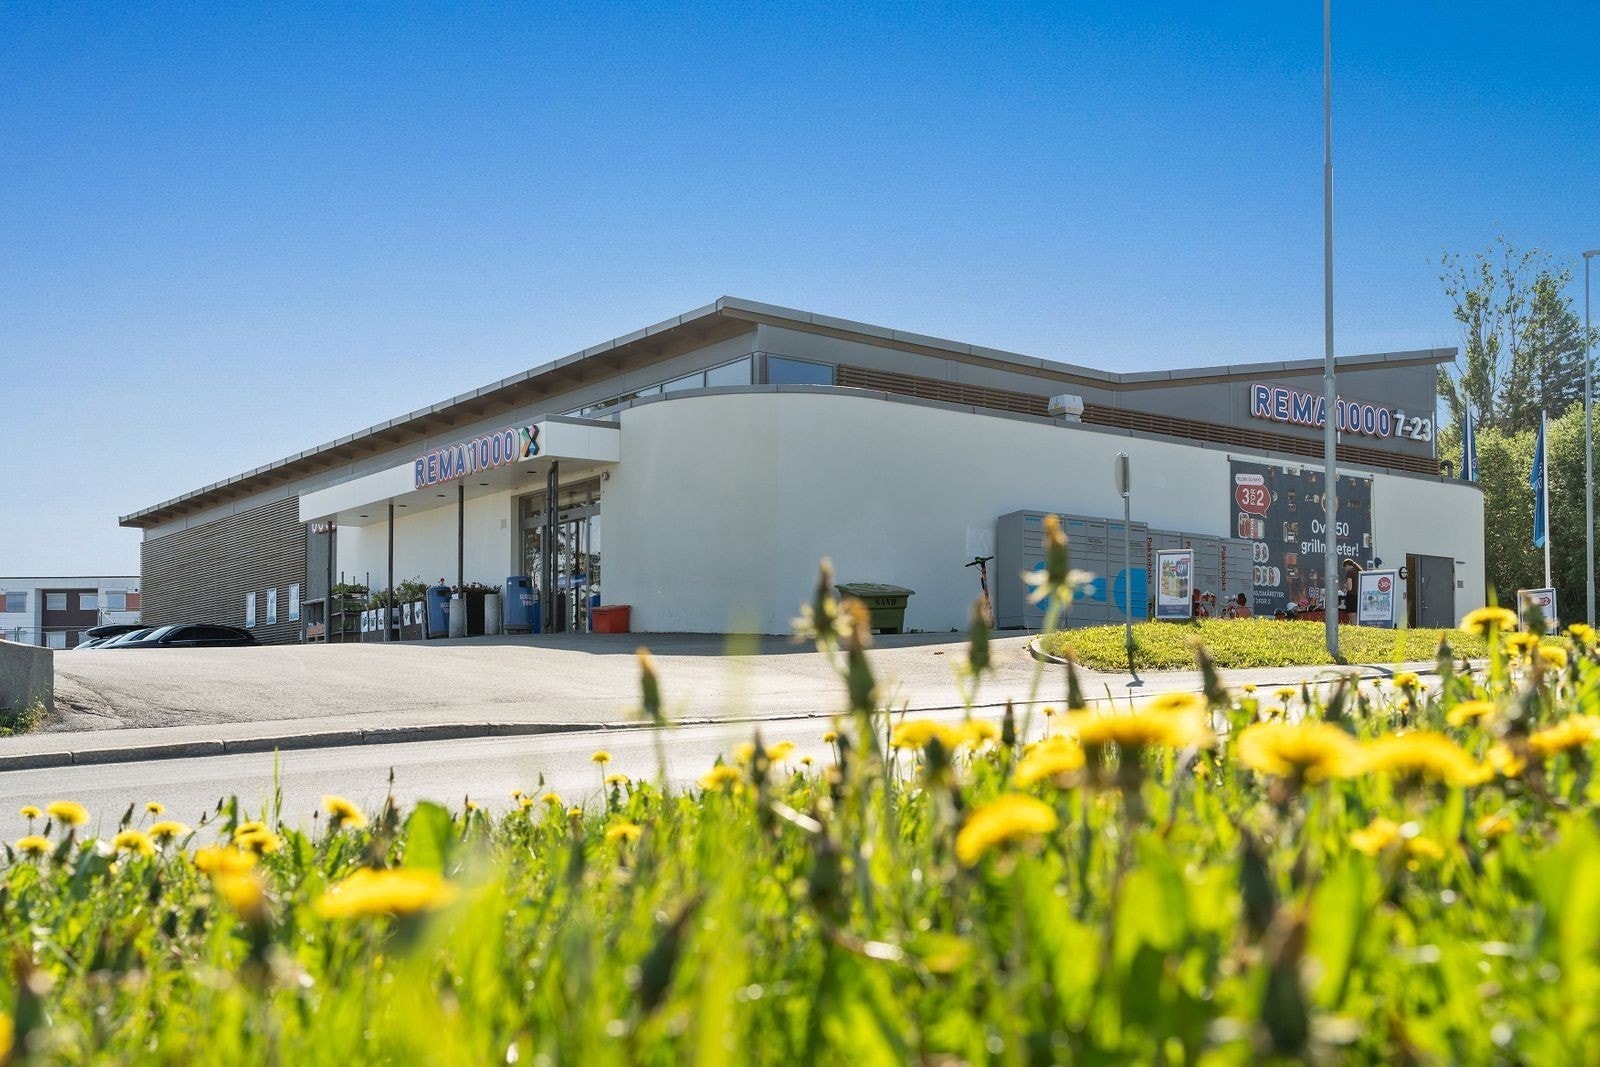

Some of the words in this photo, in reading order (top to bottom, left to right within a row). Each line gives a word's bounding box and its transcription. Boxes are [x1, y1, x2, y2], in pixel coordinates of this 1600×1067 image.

[1251, 384, 1326, 427] REMA
[1336, 399, 1392, 438] 1000
[1393, 412, 1432, 442] 7-23
[414, 444, 467, 490] REMA
[469, 428, 515, 473] 1000
[1242, 488, 1250, 505] 3
[1256, 489, 1265, 507] 2
[1311, 519, 1327, 534] Ov
[1335, 521, 1349, 537] 50
[1301, 538, 1359, 557] grillneter!
